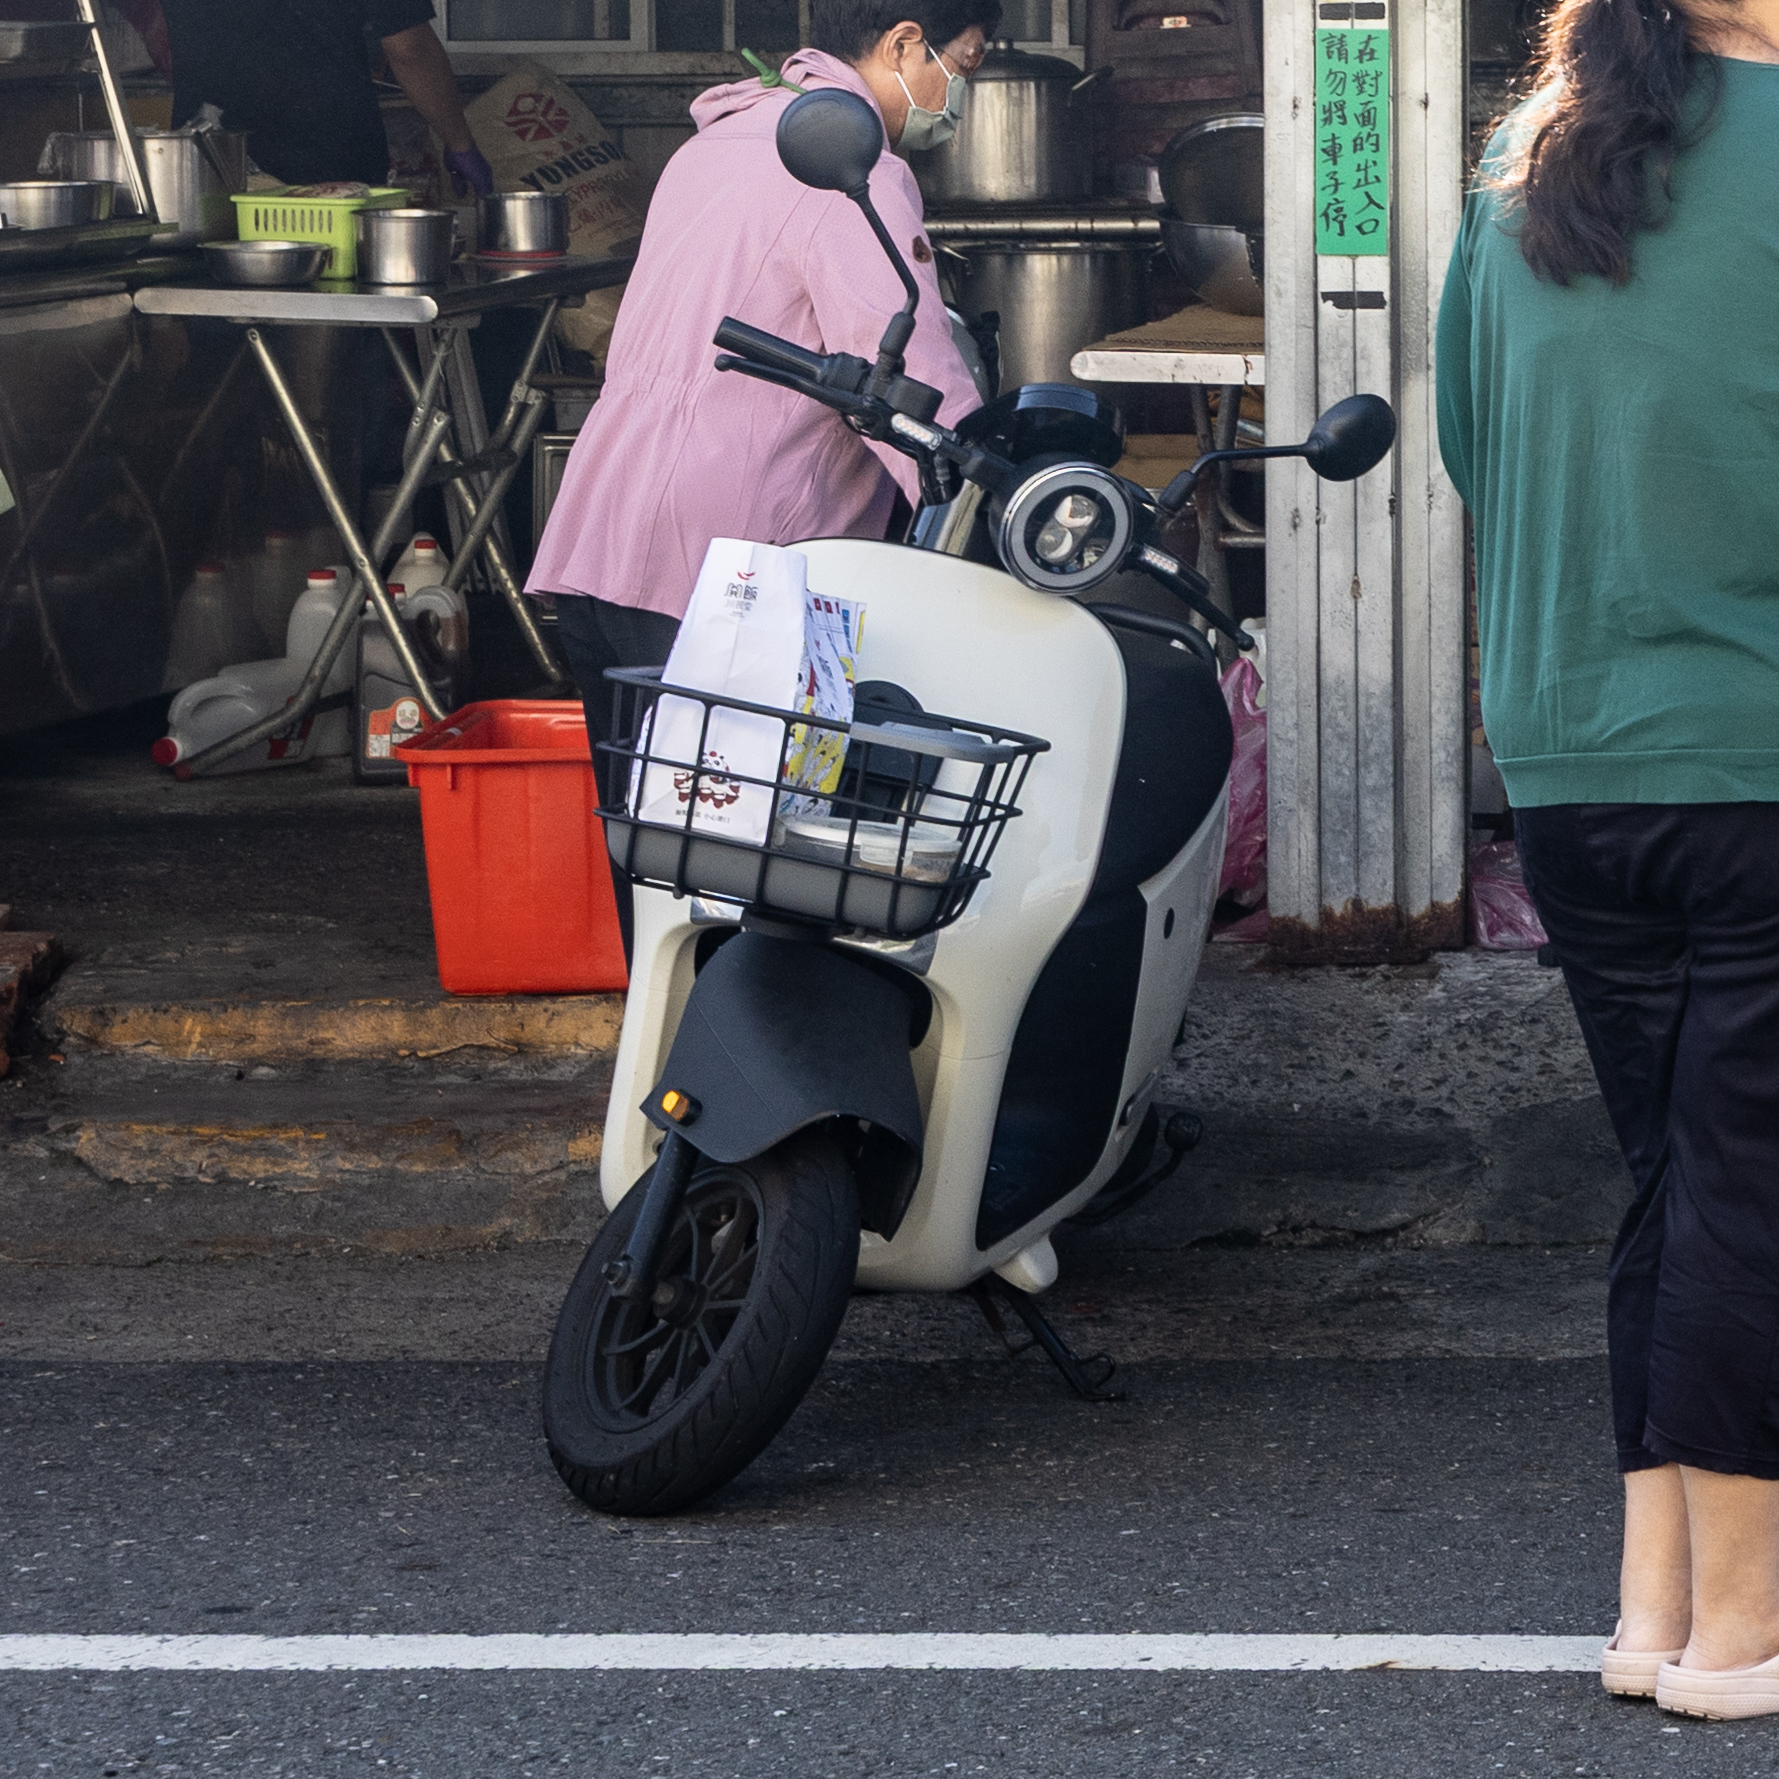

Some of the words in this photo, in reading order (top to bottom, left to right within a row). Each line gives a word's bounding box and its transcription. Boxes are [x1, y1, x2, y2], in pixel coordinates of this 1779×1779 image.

[1320, 32, 1350, 238] 請勿將車子停
[1352, 33, 1386, 237] 在對面的出入口
